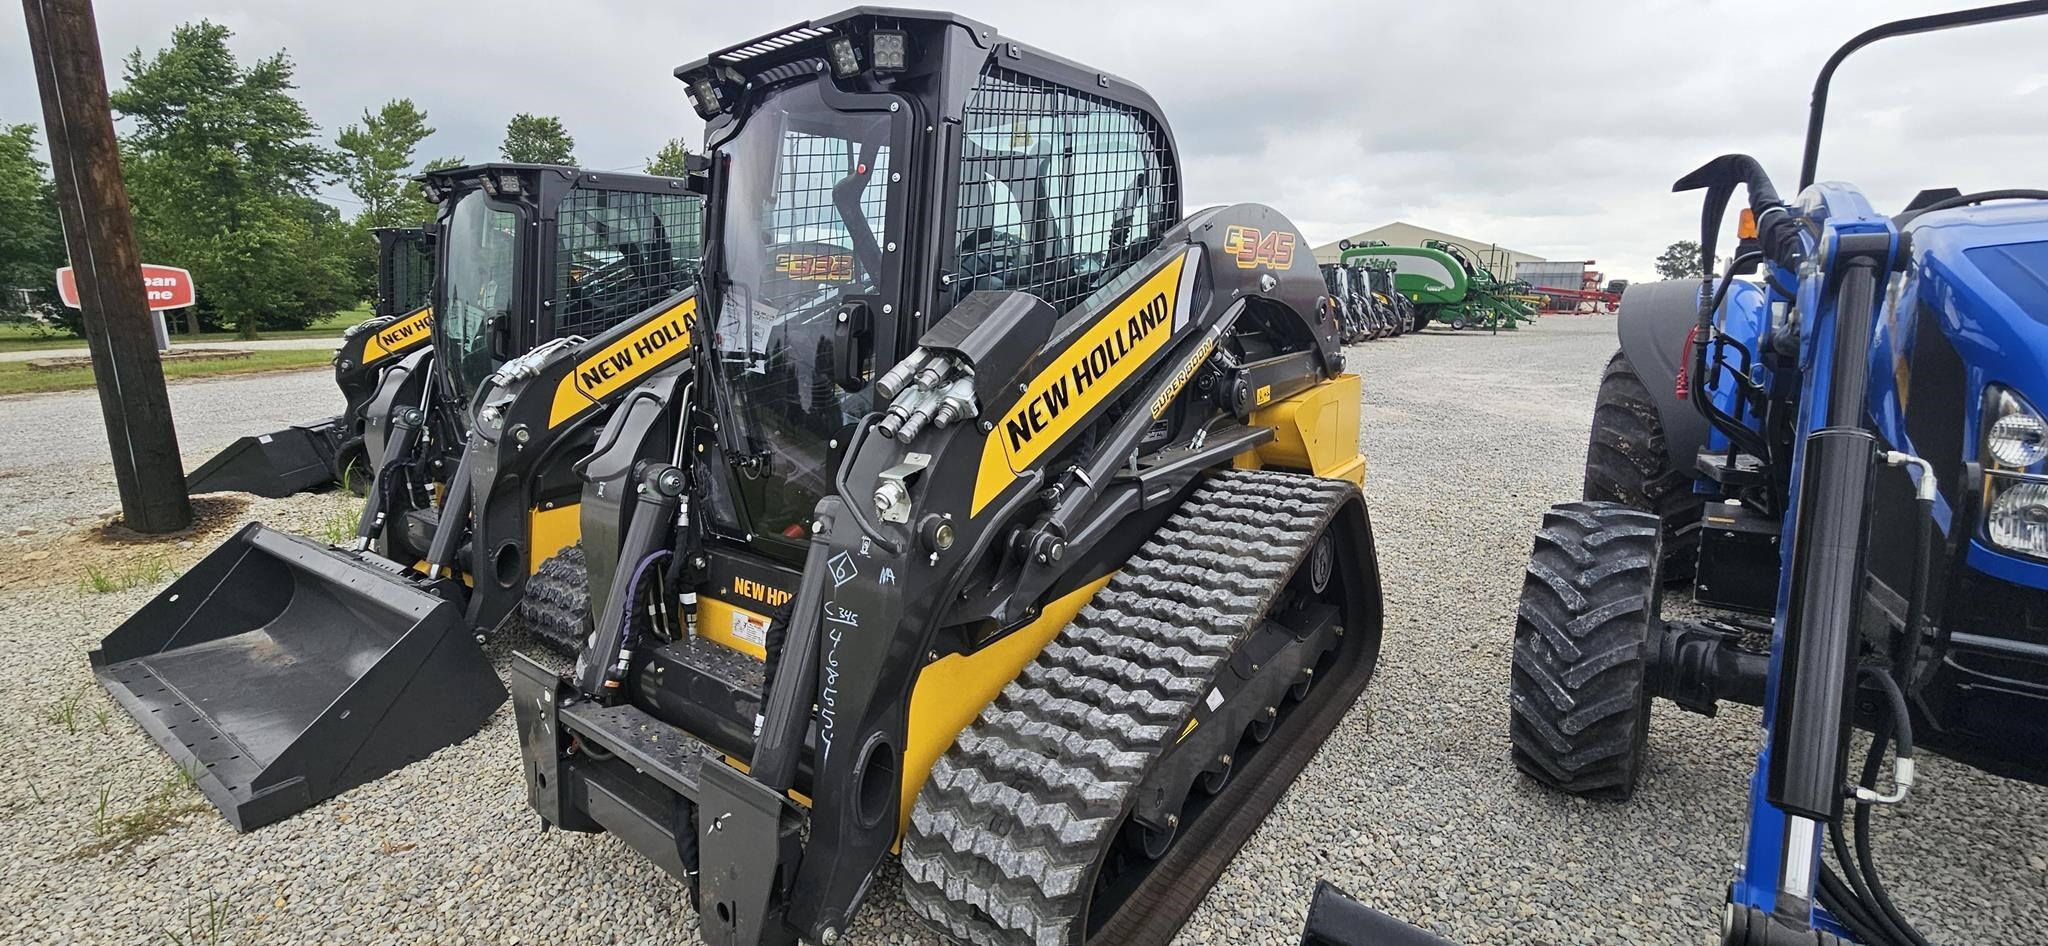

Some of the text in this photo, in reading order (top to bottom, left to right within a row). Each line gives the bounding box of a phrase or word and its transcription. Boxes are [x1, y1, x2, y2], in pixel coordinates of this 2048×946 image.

[1224, 225, 1296, 270] C345
[381, 324, 414, 346] NEW
[580, 347, 634, 390] NEW
[633, 309, 697, 359] HOLLA
[1006, 292, 1168, 453] NEW HOLLAND
[1150, 370, 1189, 419] SUPER
[734, 576, 765, 602] NEW
